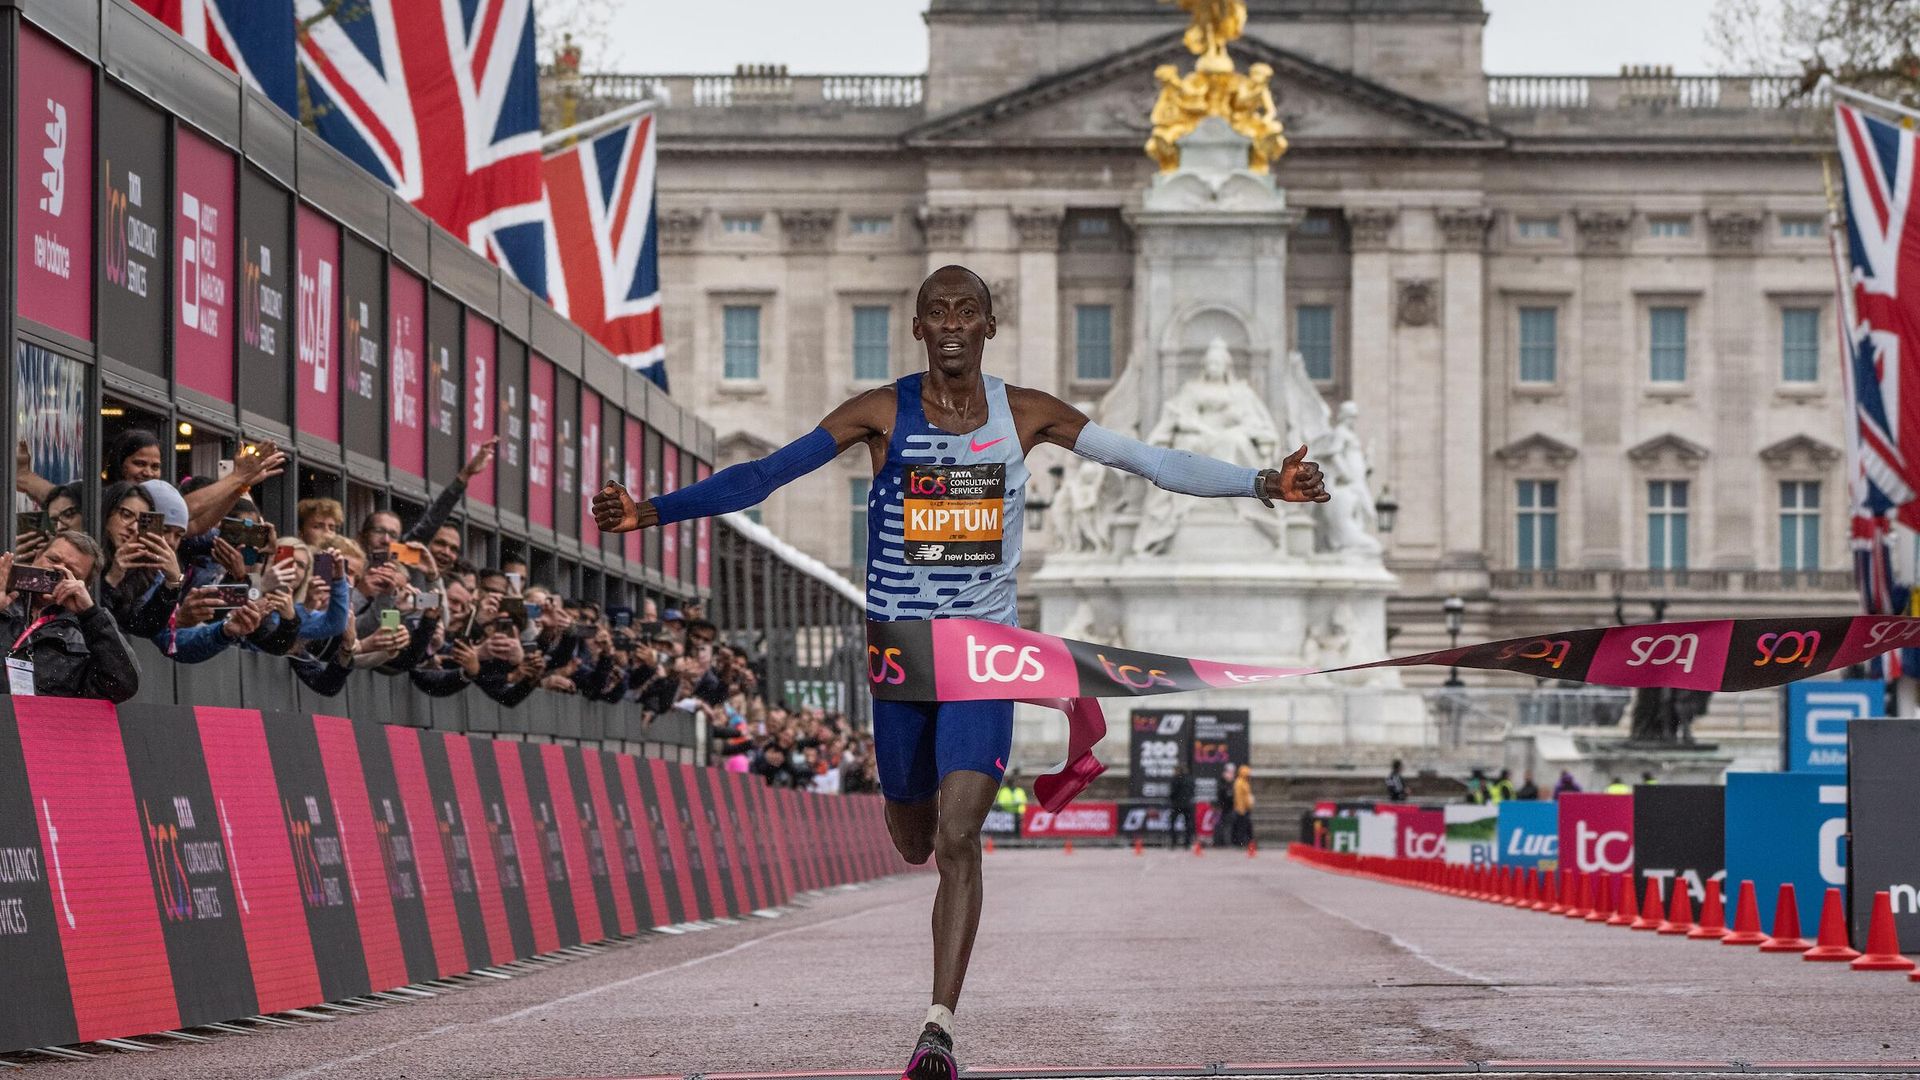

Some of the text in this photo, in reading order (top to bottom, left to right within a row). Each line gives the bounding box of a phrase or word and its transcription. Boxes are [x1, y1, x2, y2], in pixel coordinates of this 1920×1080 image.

[911, 471, 947, 495] tcs
[950, 478, 1000, 487] CONSULTANCY
[950, 487, 983, 495] SERVICES
[911, 508, 998, 531] KIPTUM
[964, 552, 996, 561] balance
[966, 634, 1045, 683] tcs
[1496, 639, 1571, 669] tcs
[1626, 633, 1699, 673] tcs
[1753, 630, 1821, 668] tcs
[1097, 653, 1176, 689] tcs
[0, 846, 40, 883] ULTANCY
[1889, 884, 1920, 914] n
[0, 897, 28, 935] VICES
